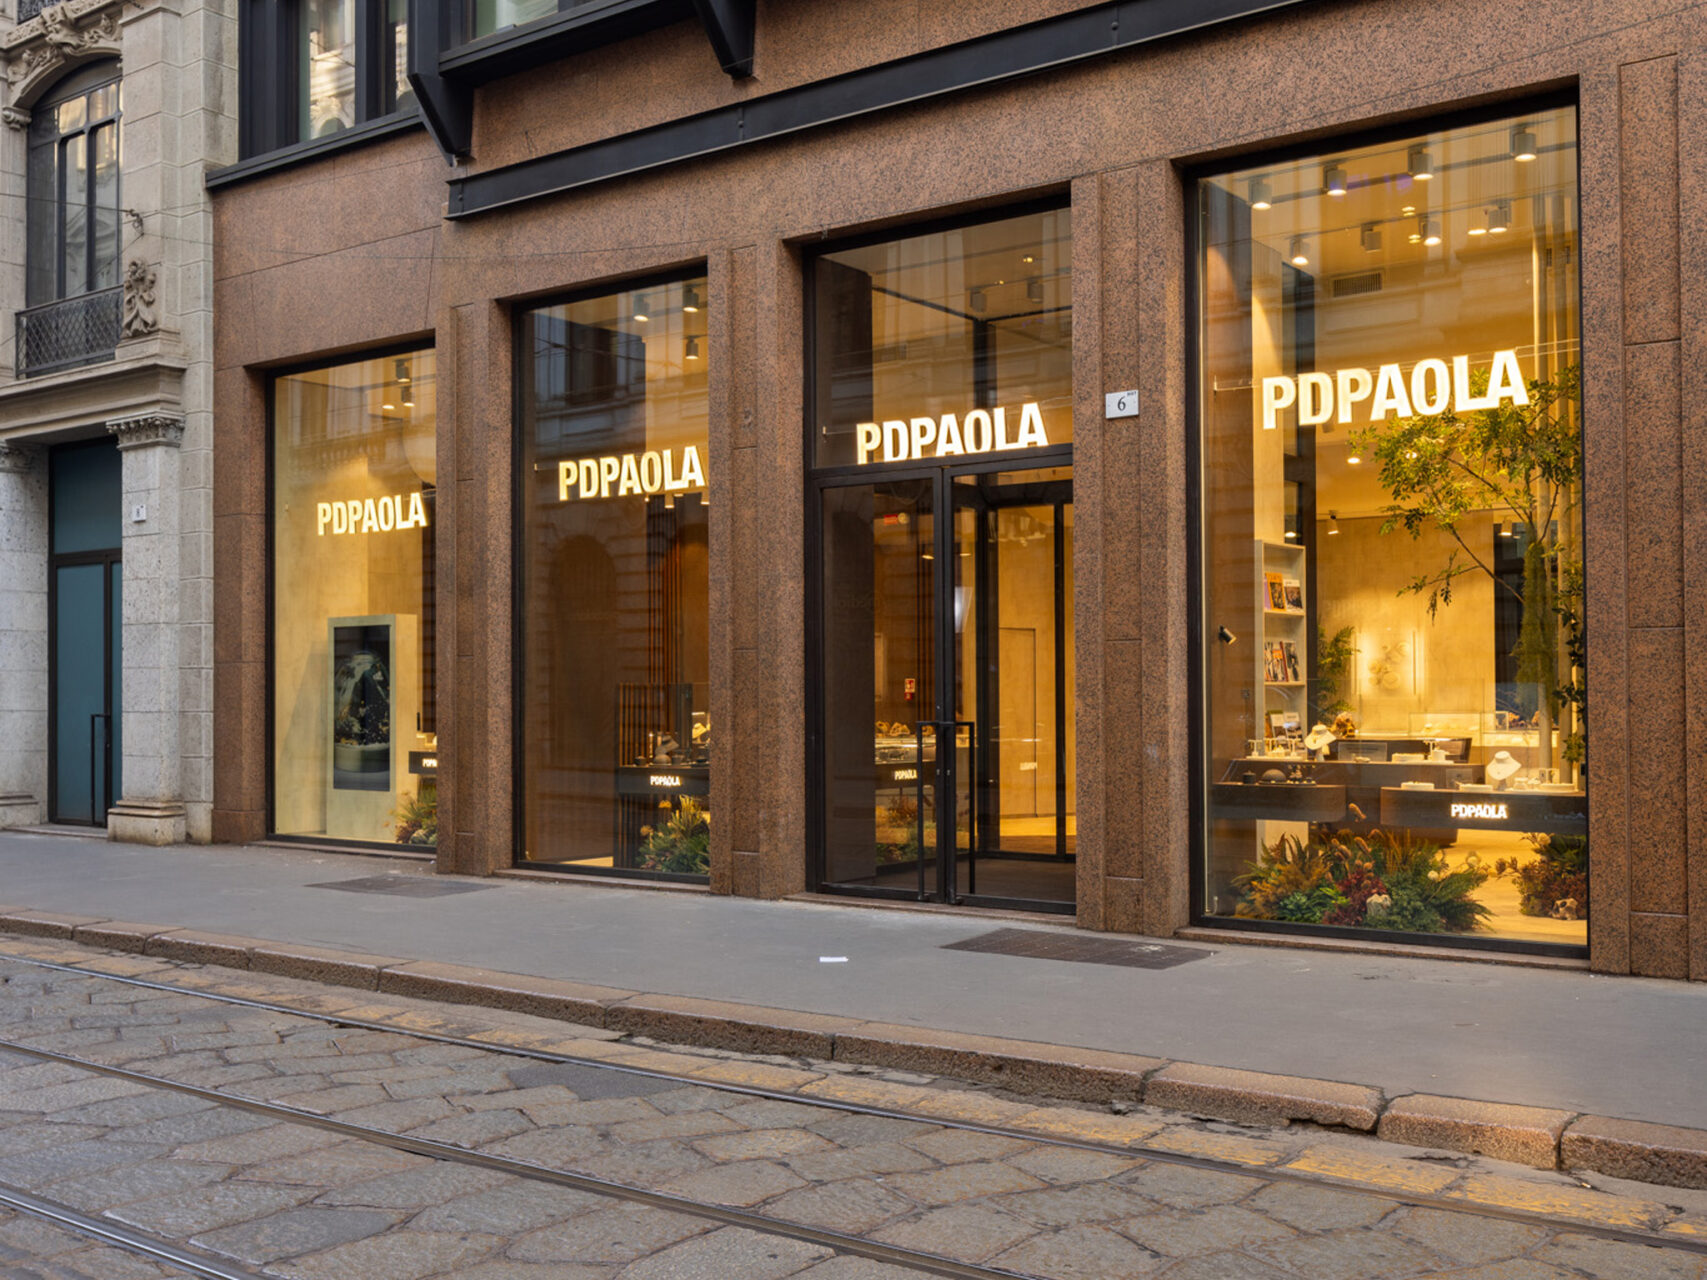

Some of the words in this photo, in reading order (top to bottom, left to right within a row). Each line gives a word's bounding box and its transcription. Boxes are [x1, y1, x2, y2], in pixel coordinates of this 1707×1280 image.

[1117, 395, 1126, 411] 6
[1261, 348, 1530, 430] PDPAOLA
[856, 402, 1049, 465] PDPAOLA
[559, 445, 706, 501] PDPAOLA
[317, 492, 428, 537] PDPAOLA
[1450, 803, 1508, 820] PDPAOLA
